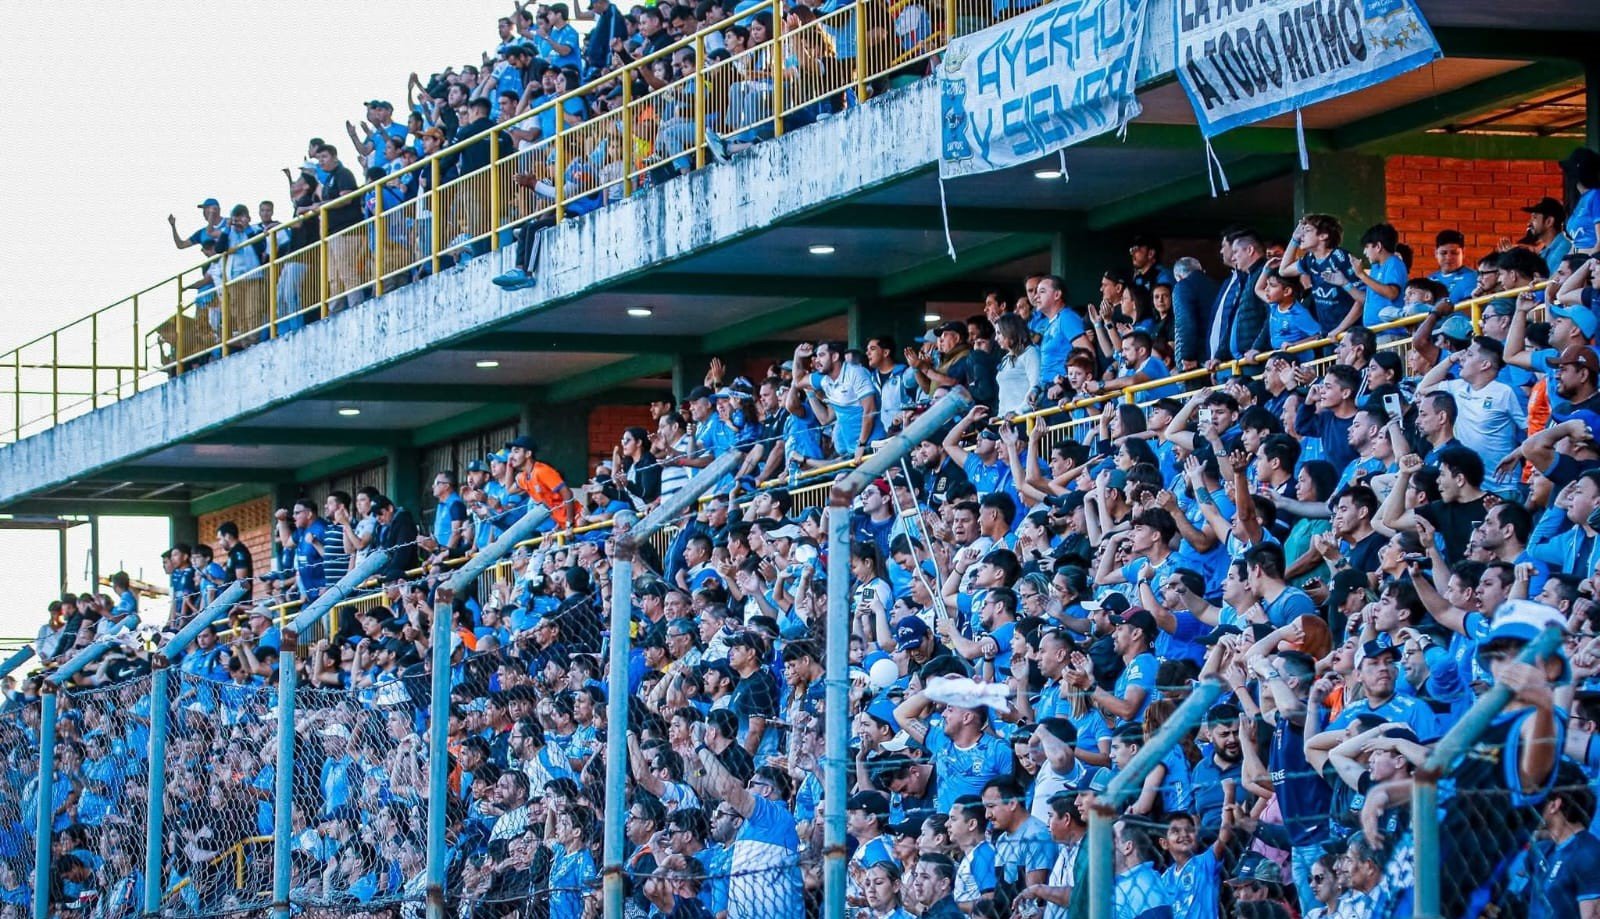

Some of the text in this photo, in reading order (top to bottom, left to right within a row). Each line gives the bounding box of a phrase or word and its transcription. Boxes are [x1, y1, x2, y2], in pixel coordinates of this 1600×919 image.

[1203, 18, 1283, 101] TODO
[1278, 0, 1369, 83] RITMO
[969, 108, 995, 170] Y
